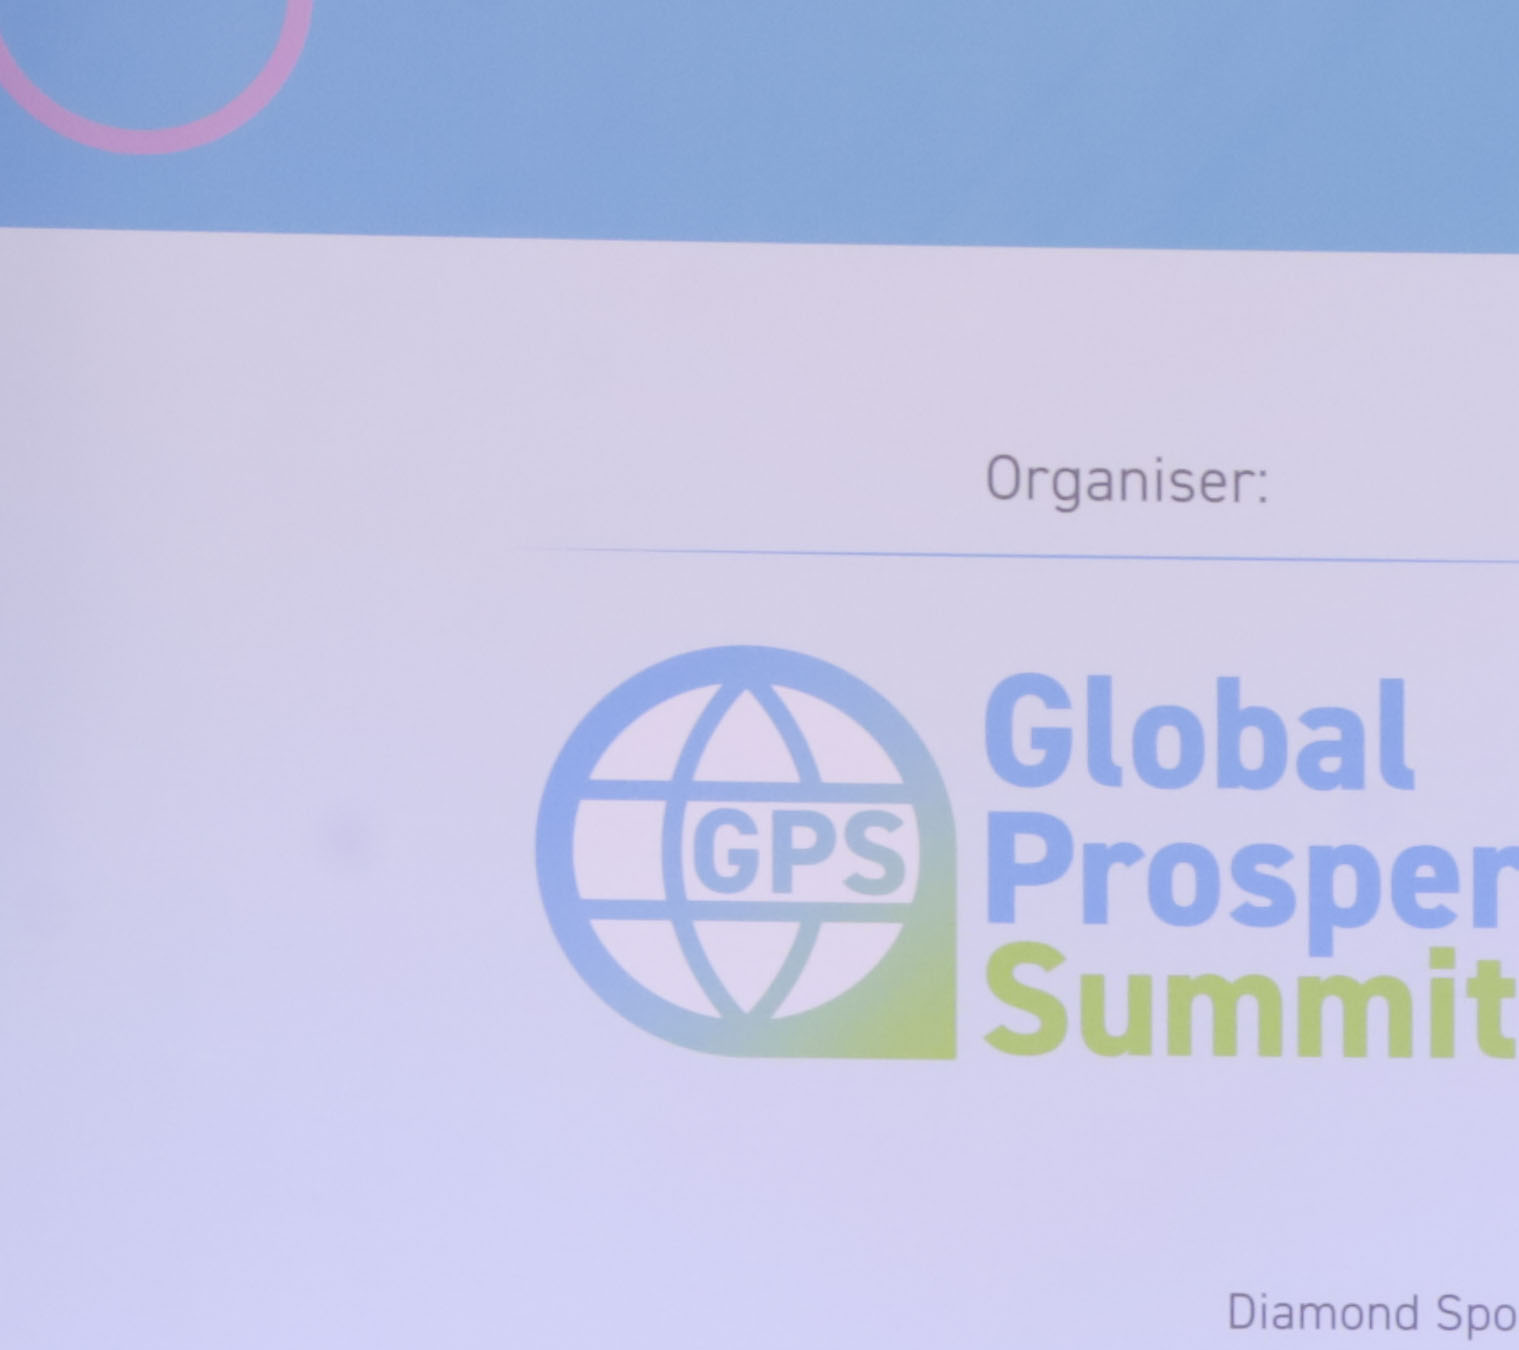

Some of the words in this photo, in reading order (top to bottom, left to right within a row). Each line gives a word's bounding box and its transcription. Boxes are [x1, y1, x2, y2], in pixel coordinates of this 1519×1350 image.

[987, 454, 1266, 513] Organiser:
[985, 673, 1415, 791] Global
[694, 808, 905, 895] GPS
[984, 941, 1515, 1059] Summit
[1229, 1292, 1418, 1331] Diamond
